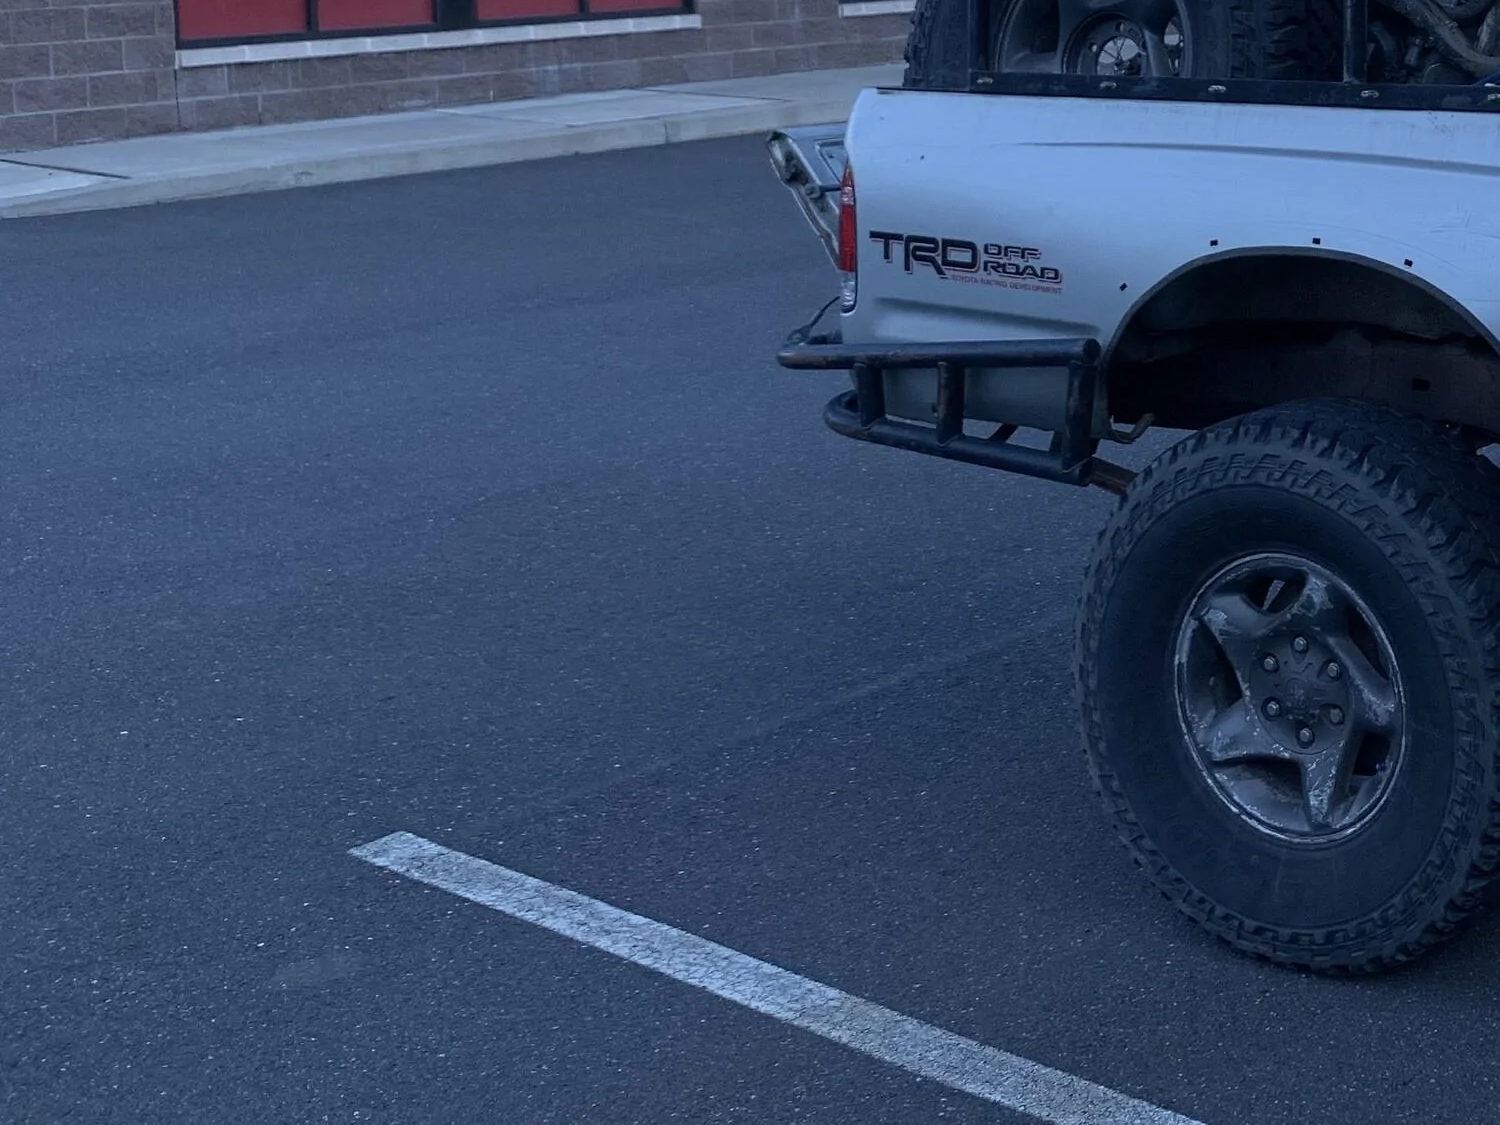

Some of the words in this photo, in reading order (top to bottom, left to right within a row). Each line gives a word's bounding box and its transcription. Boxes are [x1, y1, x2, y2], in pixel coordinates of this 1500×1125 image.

[869, 230, 981, 280] TRD
[983, 242, 1043, 263] OFF
[982, 260, 1063, 284] ROAD
[952, 274, 978, 285] TOYOTA
[980, 278, 1008, 289] RACING
[1009, 281, 1063, 295] DEVELOPMENT
